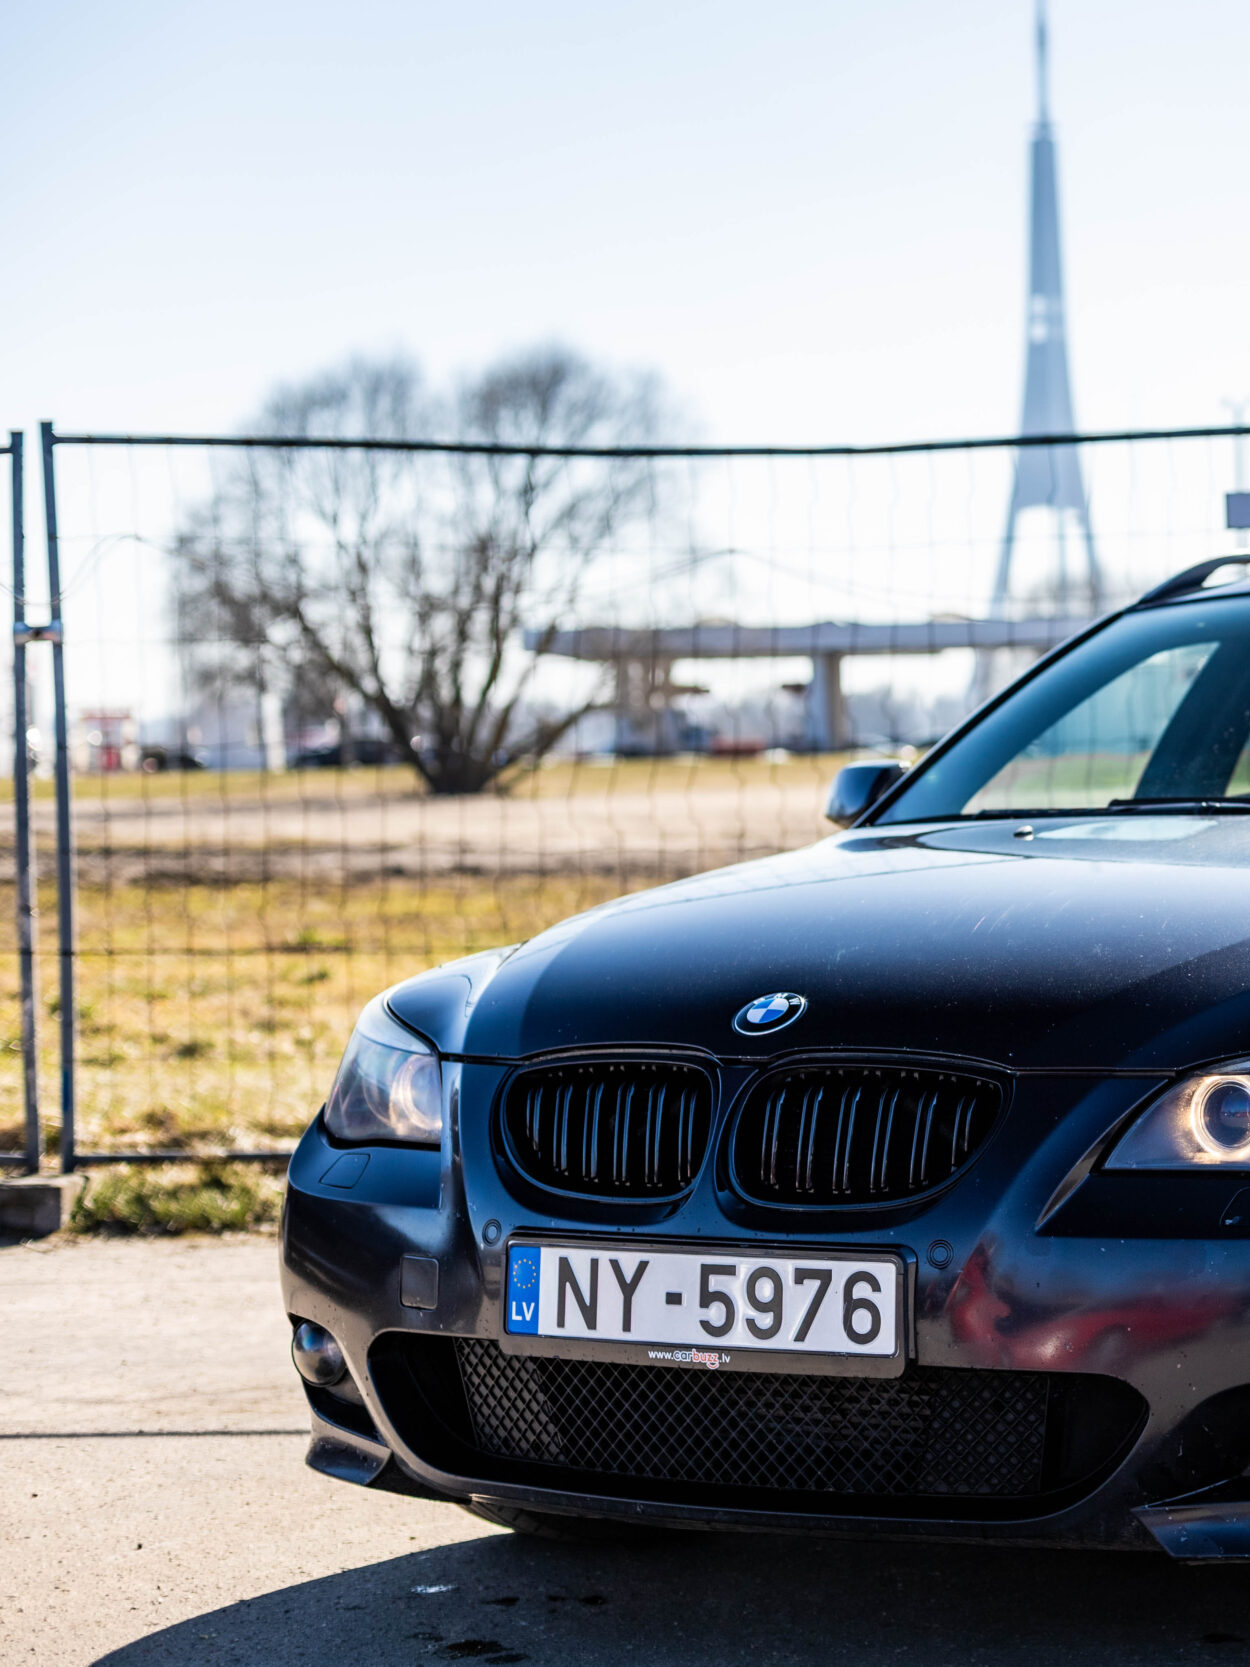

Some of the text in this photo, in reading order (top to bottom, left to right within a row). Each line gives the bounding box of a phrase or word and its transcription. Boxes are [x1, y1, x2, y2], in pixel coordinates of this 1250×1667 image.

[556, 1256, 882, 1345] NY-5976
[511, 1301, 535, 1321] LV
[647, 1348, 731, 1366] www.carbuzz.lv
